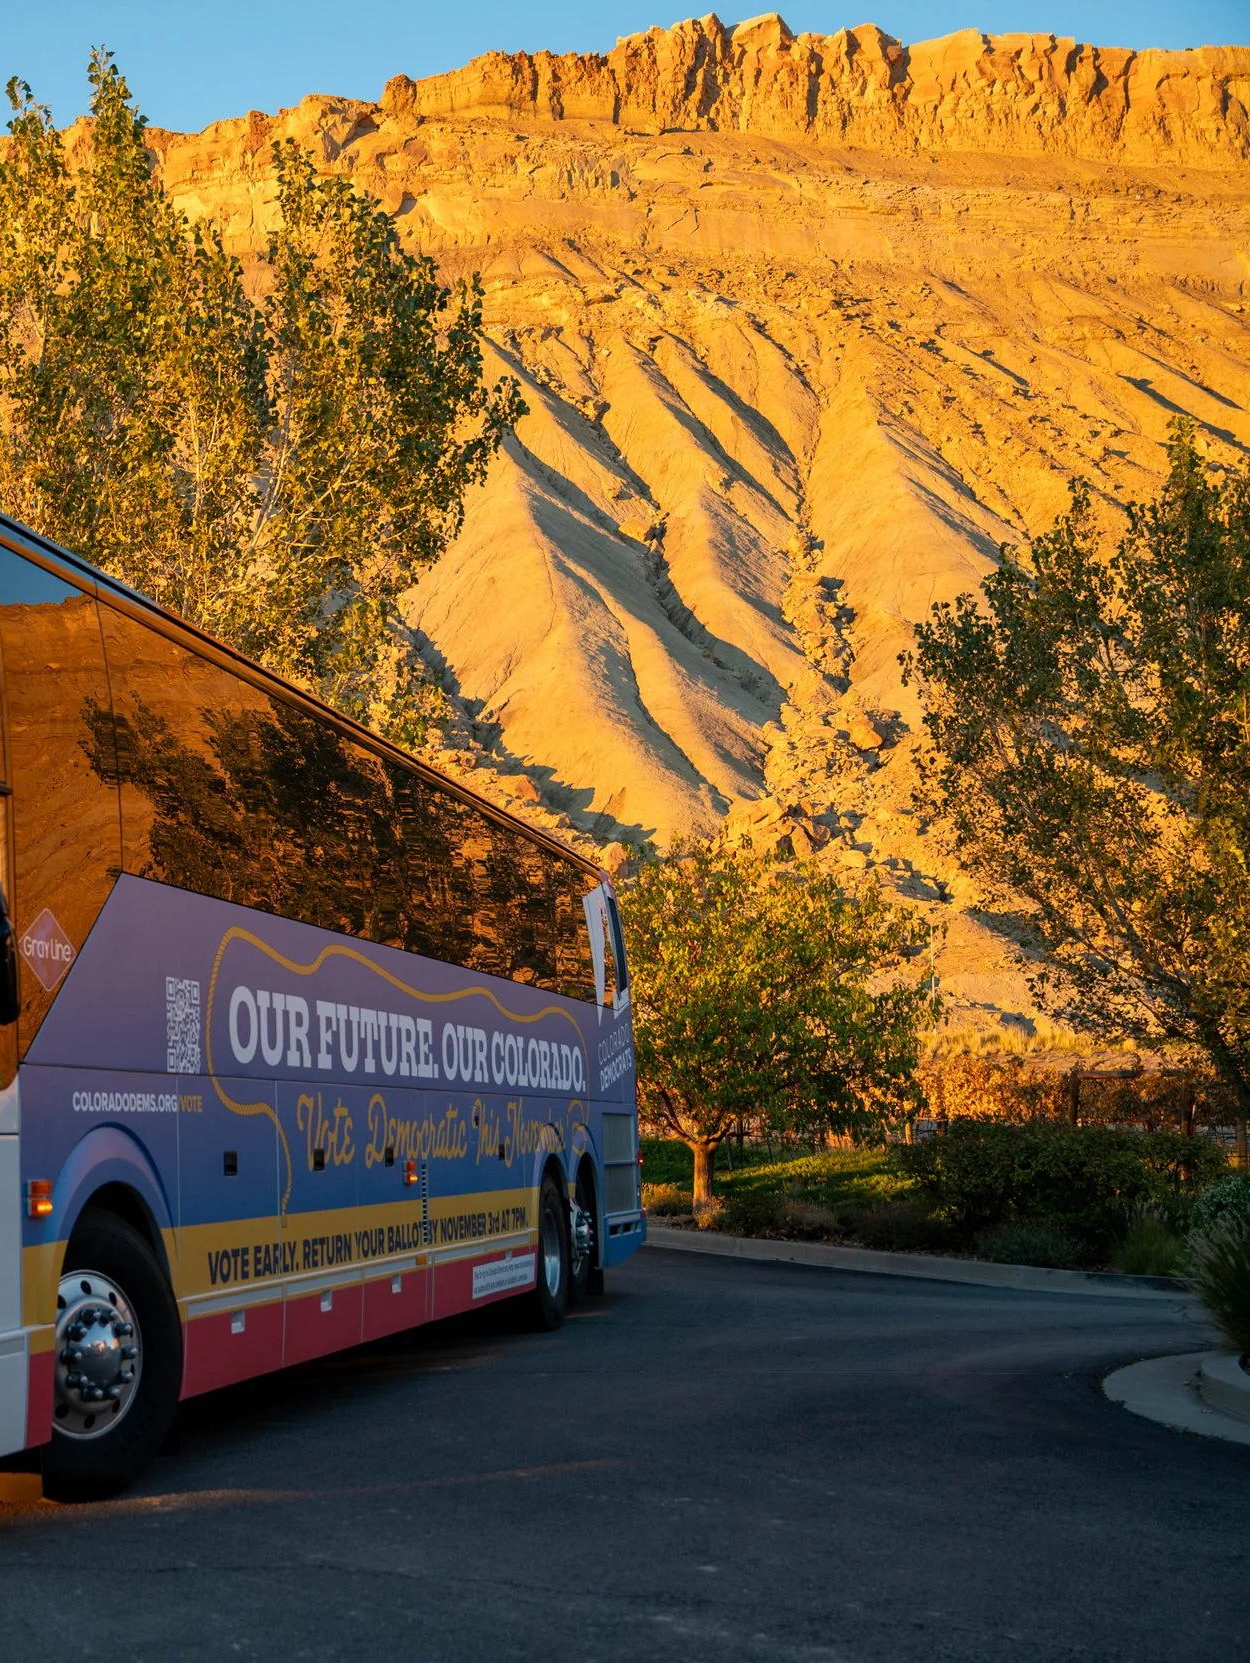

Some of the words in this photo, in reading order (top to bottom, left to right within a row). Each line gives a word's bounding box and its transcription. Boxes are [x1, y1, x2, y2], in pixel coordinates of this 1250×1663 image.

[229, 985, 312, 1068] OUR
[316, 1000, 439, 1079] FUTURE.
[442, 1022, 489, 1083] OUR
[491, 1031, 586, 1093] COLORADO.
[598, 1023, 630, 1065] COLORADO
[600, 1047, 632, 1092] DEMOCRATS
[296, 1092, 355, 1171] Vote
[365, 1093, 468, 1169] Democratic
[472, 1098, 500, 1166] This
[208, 1247, 250, 1285] VOTE
[253, 1241, 300, 1278] EARLY.
[303, 1232, 352, 1269] RETURN
[355, 1227, 386, 1258] YOUR
[387, 1221, 426, 1253] BALLOT
[440, 1212, 487, 1243] NOVEMBER
[488, 1210, 500, 1234] 3rd
[501, 1208, 511, 1232] AT
